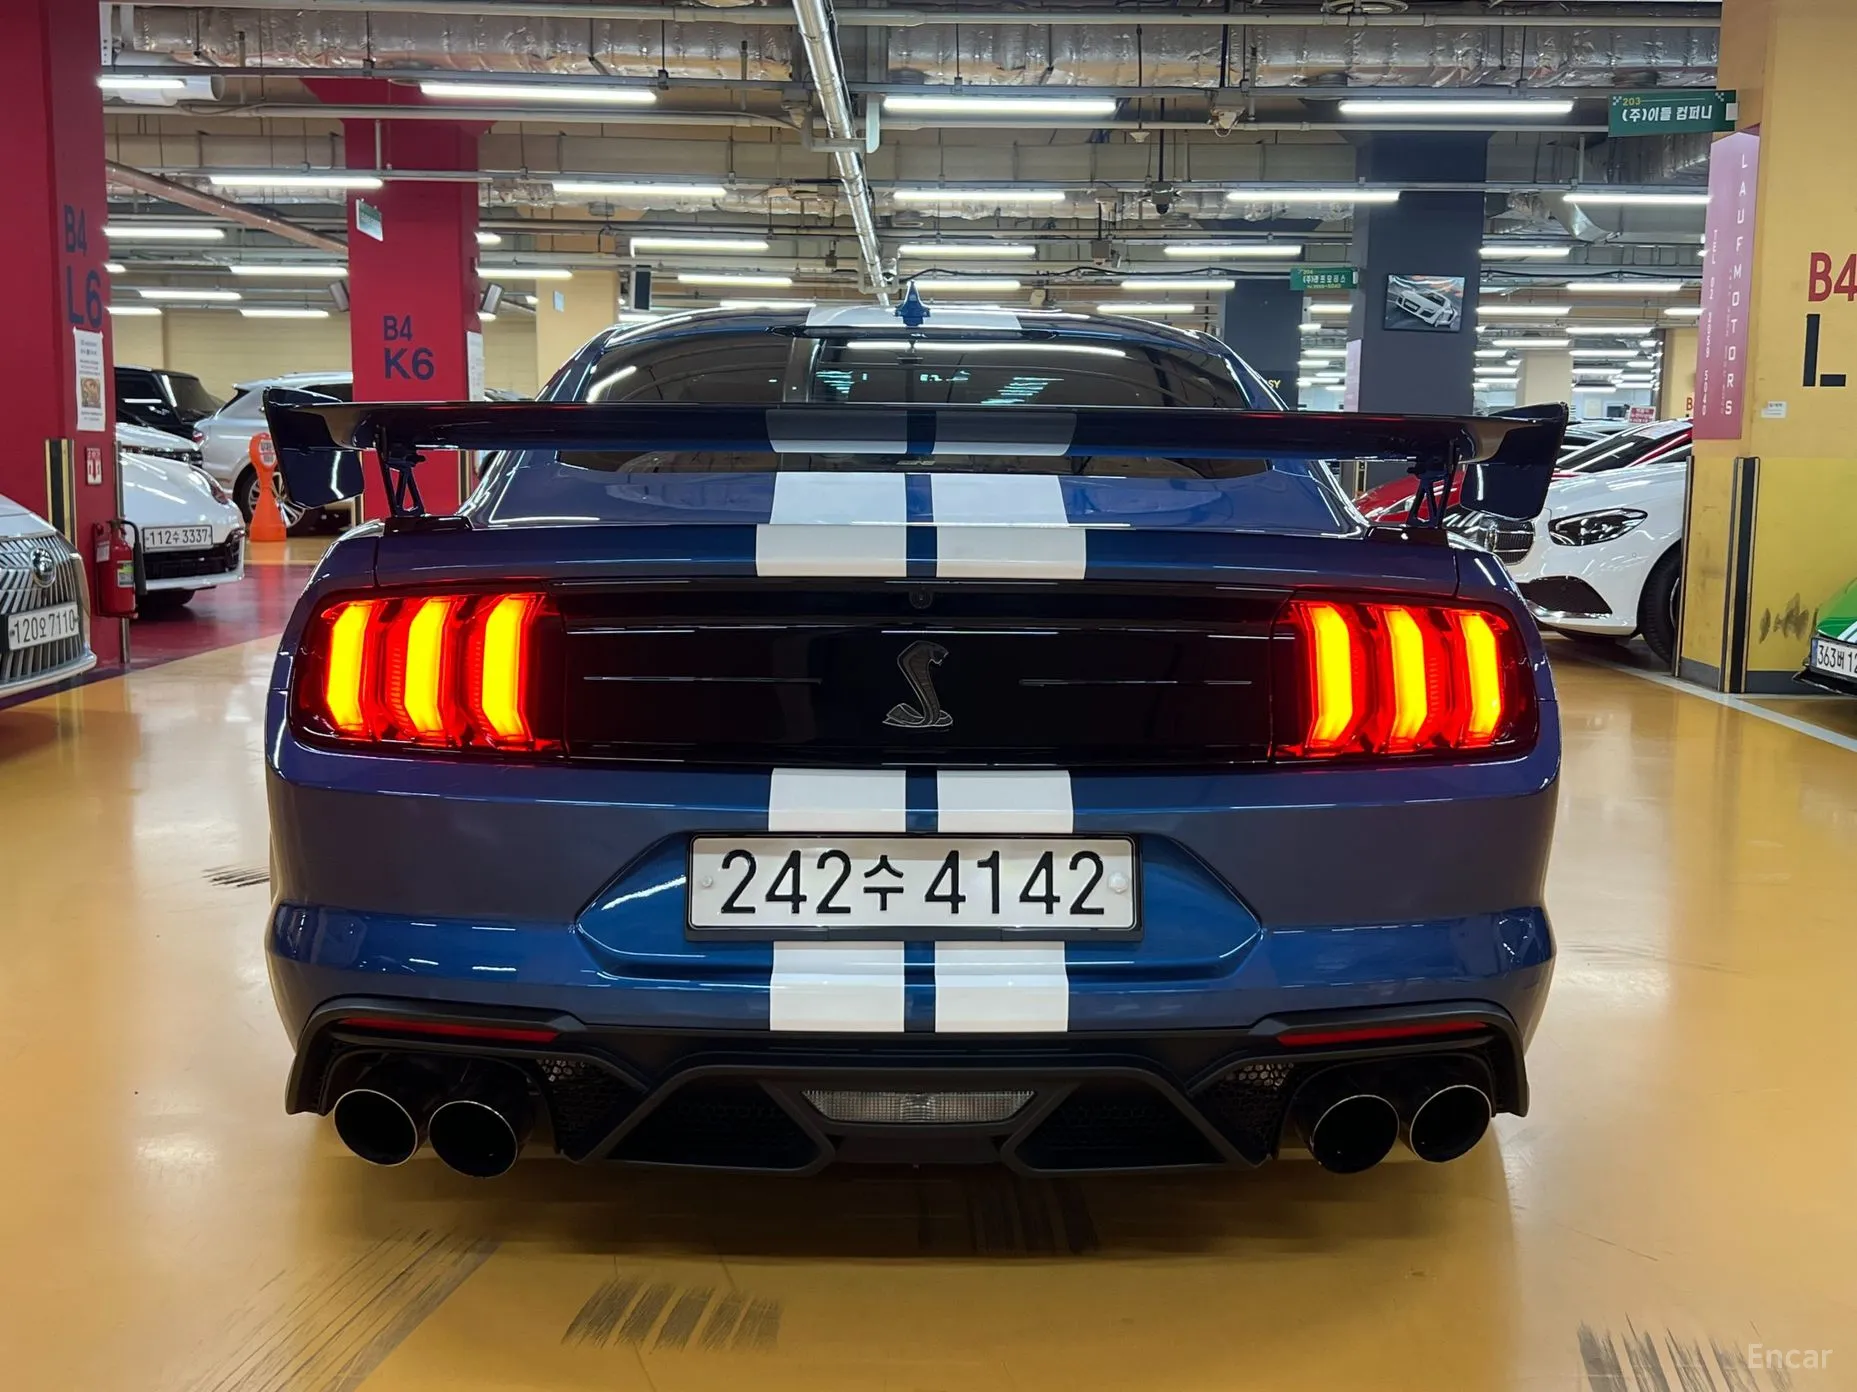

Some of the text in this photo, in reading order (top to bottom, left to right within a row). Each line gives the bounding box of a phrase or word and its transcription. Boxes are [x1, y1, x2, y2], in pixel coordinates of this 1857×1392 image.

[1622, 97, 1641, 106] 203
[1676, 104, 1713, 121] 컴퍼니
[64, 204, 88, 257] B4
[1807, 252, 1857, 302] B4
[66, 265, 104, 329] L6
[383, 315, 413, 341] B4
[384, 347, 434, 381] K6
